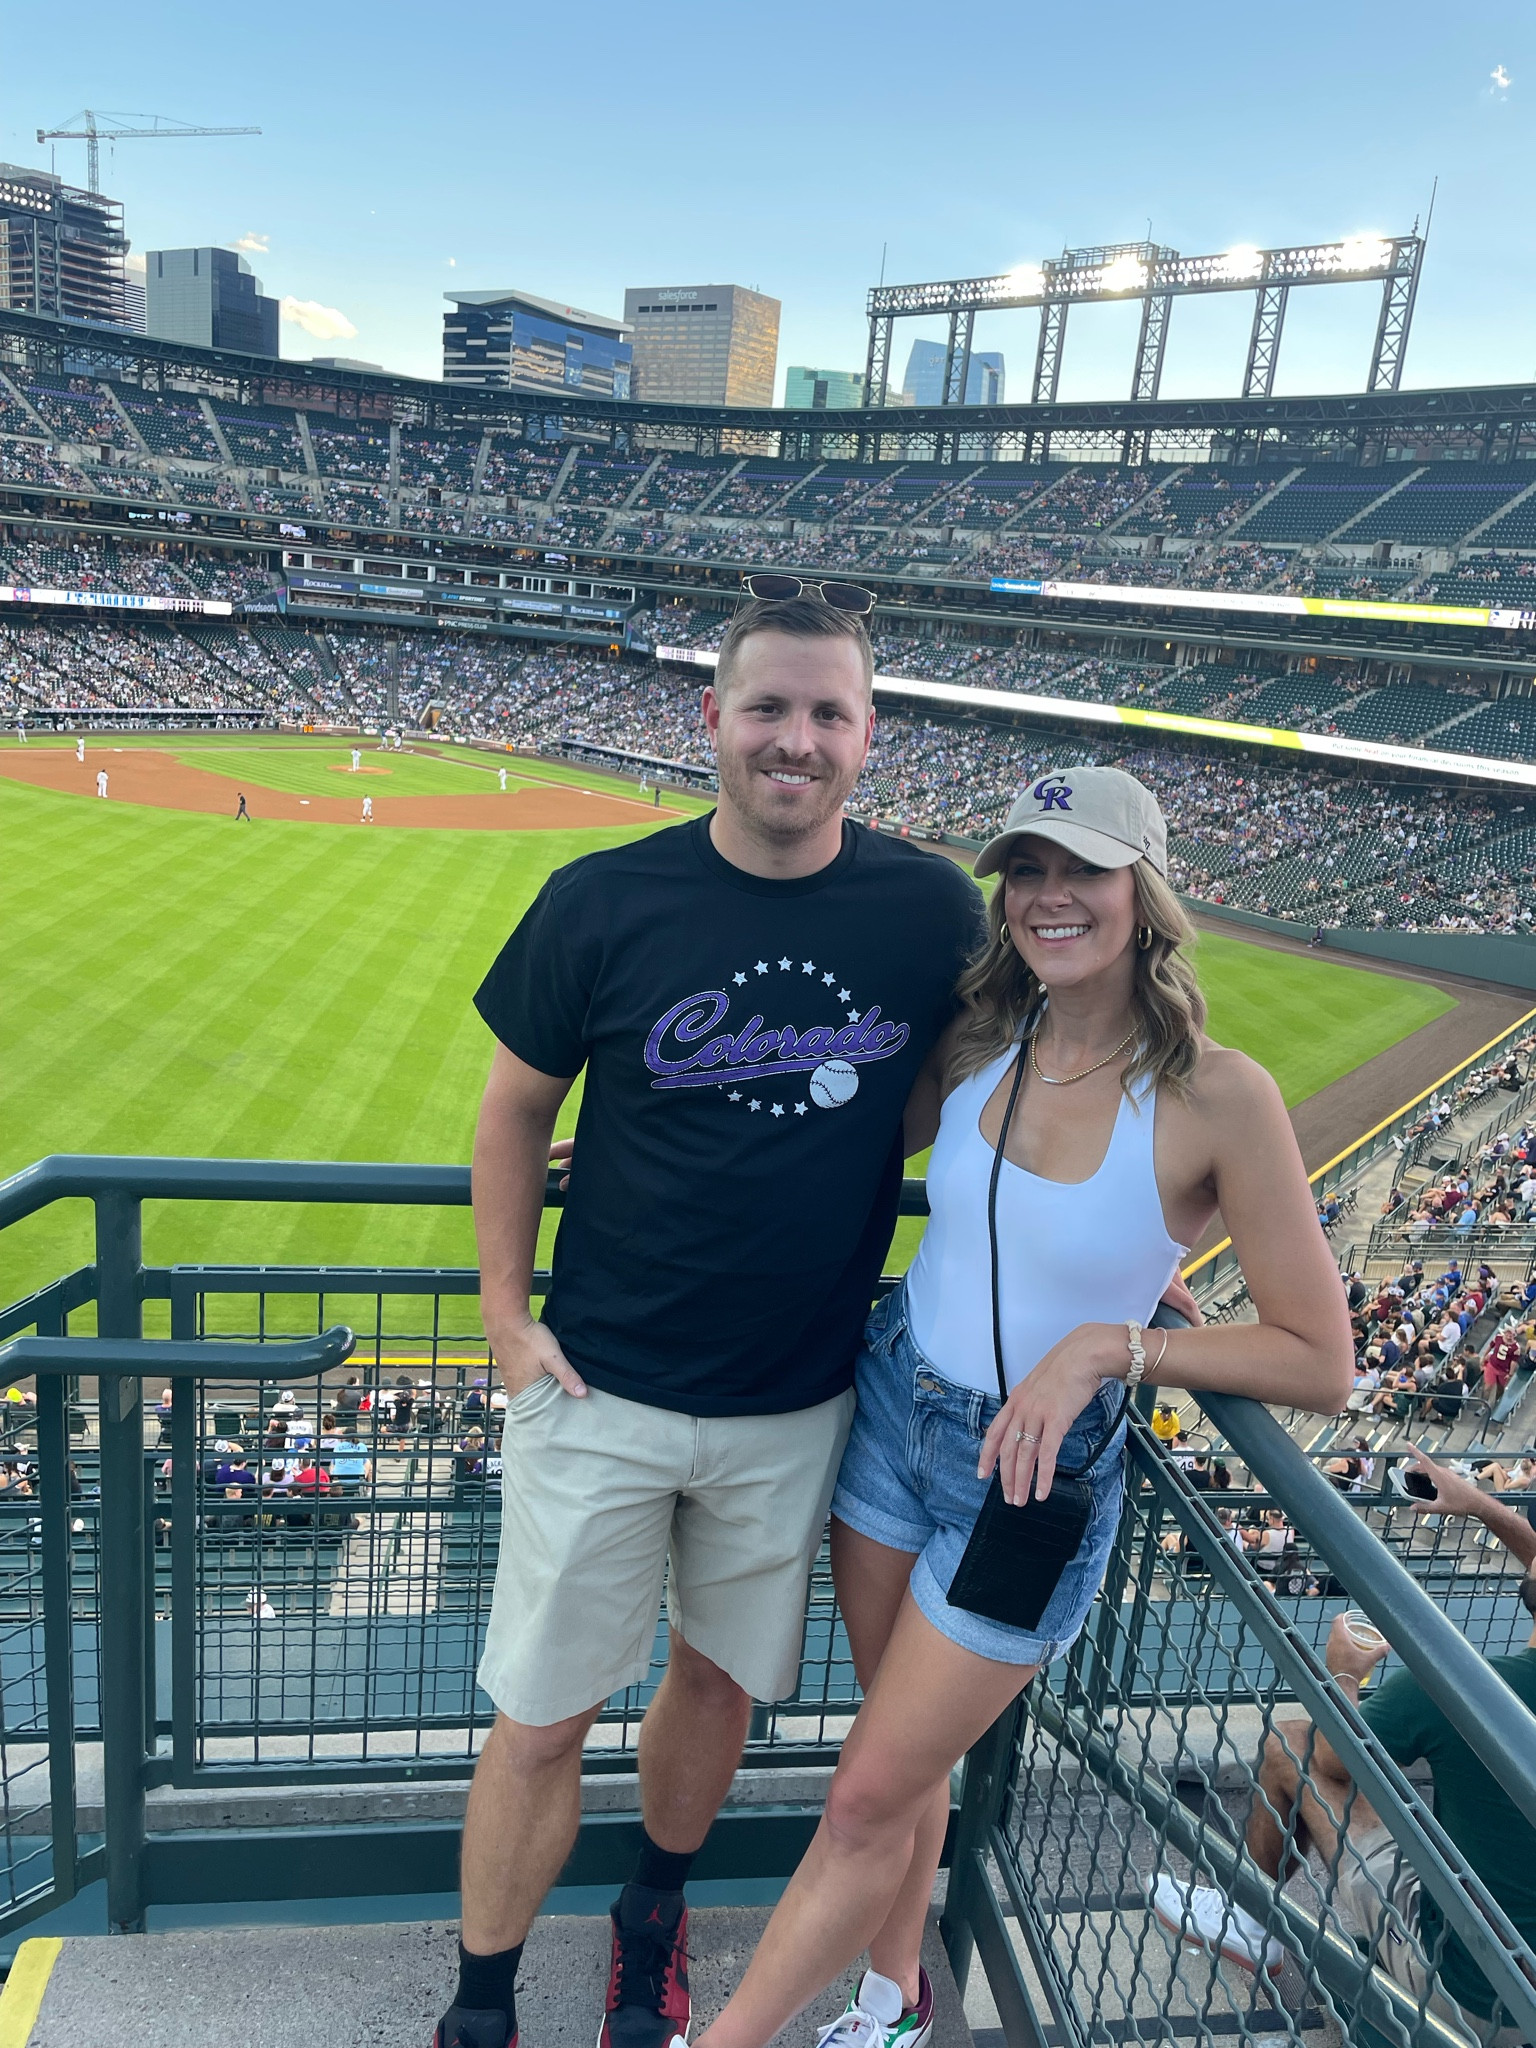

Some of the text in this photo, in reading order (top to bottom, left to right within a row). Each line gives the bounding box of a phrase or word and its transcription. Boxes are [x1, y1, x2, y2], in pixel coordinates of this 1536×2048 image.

[658, 289, 697, 302] salesforce
[1034, 775, 1073, 812] CR
[644, 990, 910, 1087] Colorado
[1180, 1461, 1193, 1470] 49
